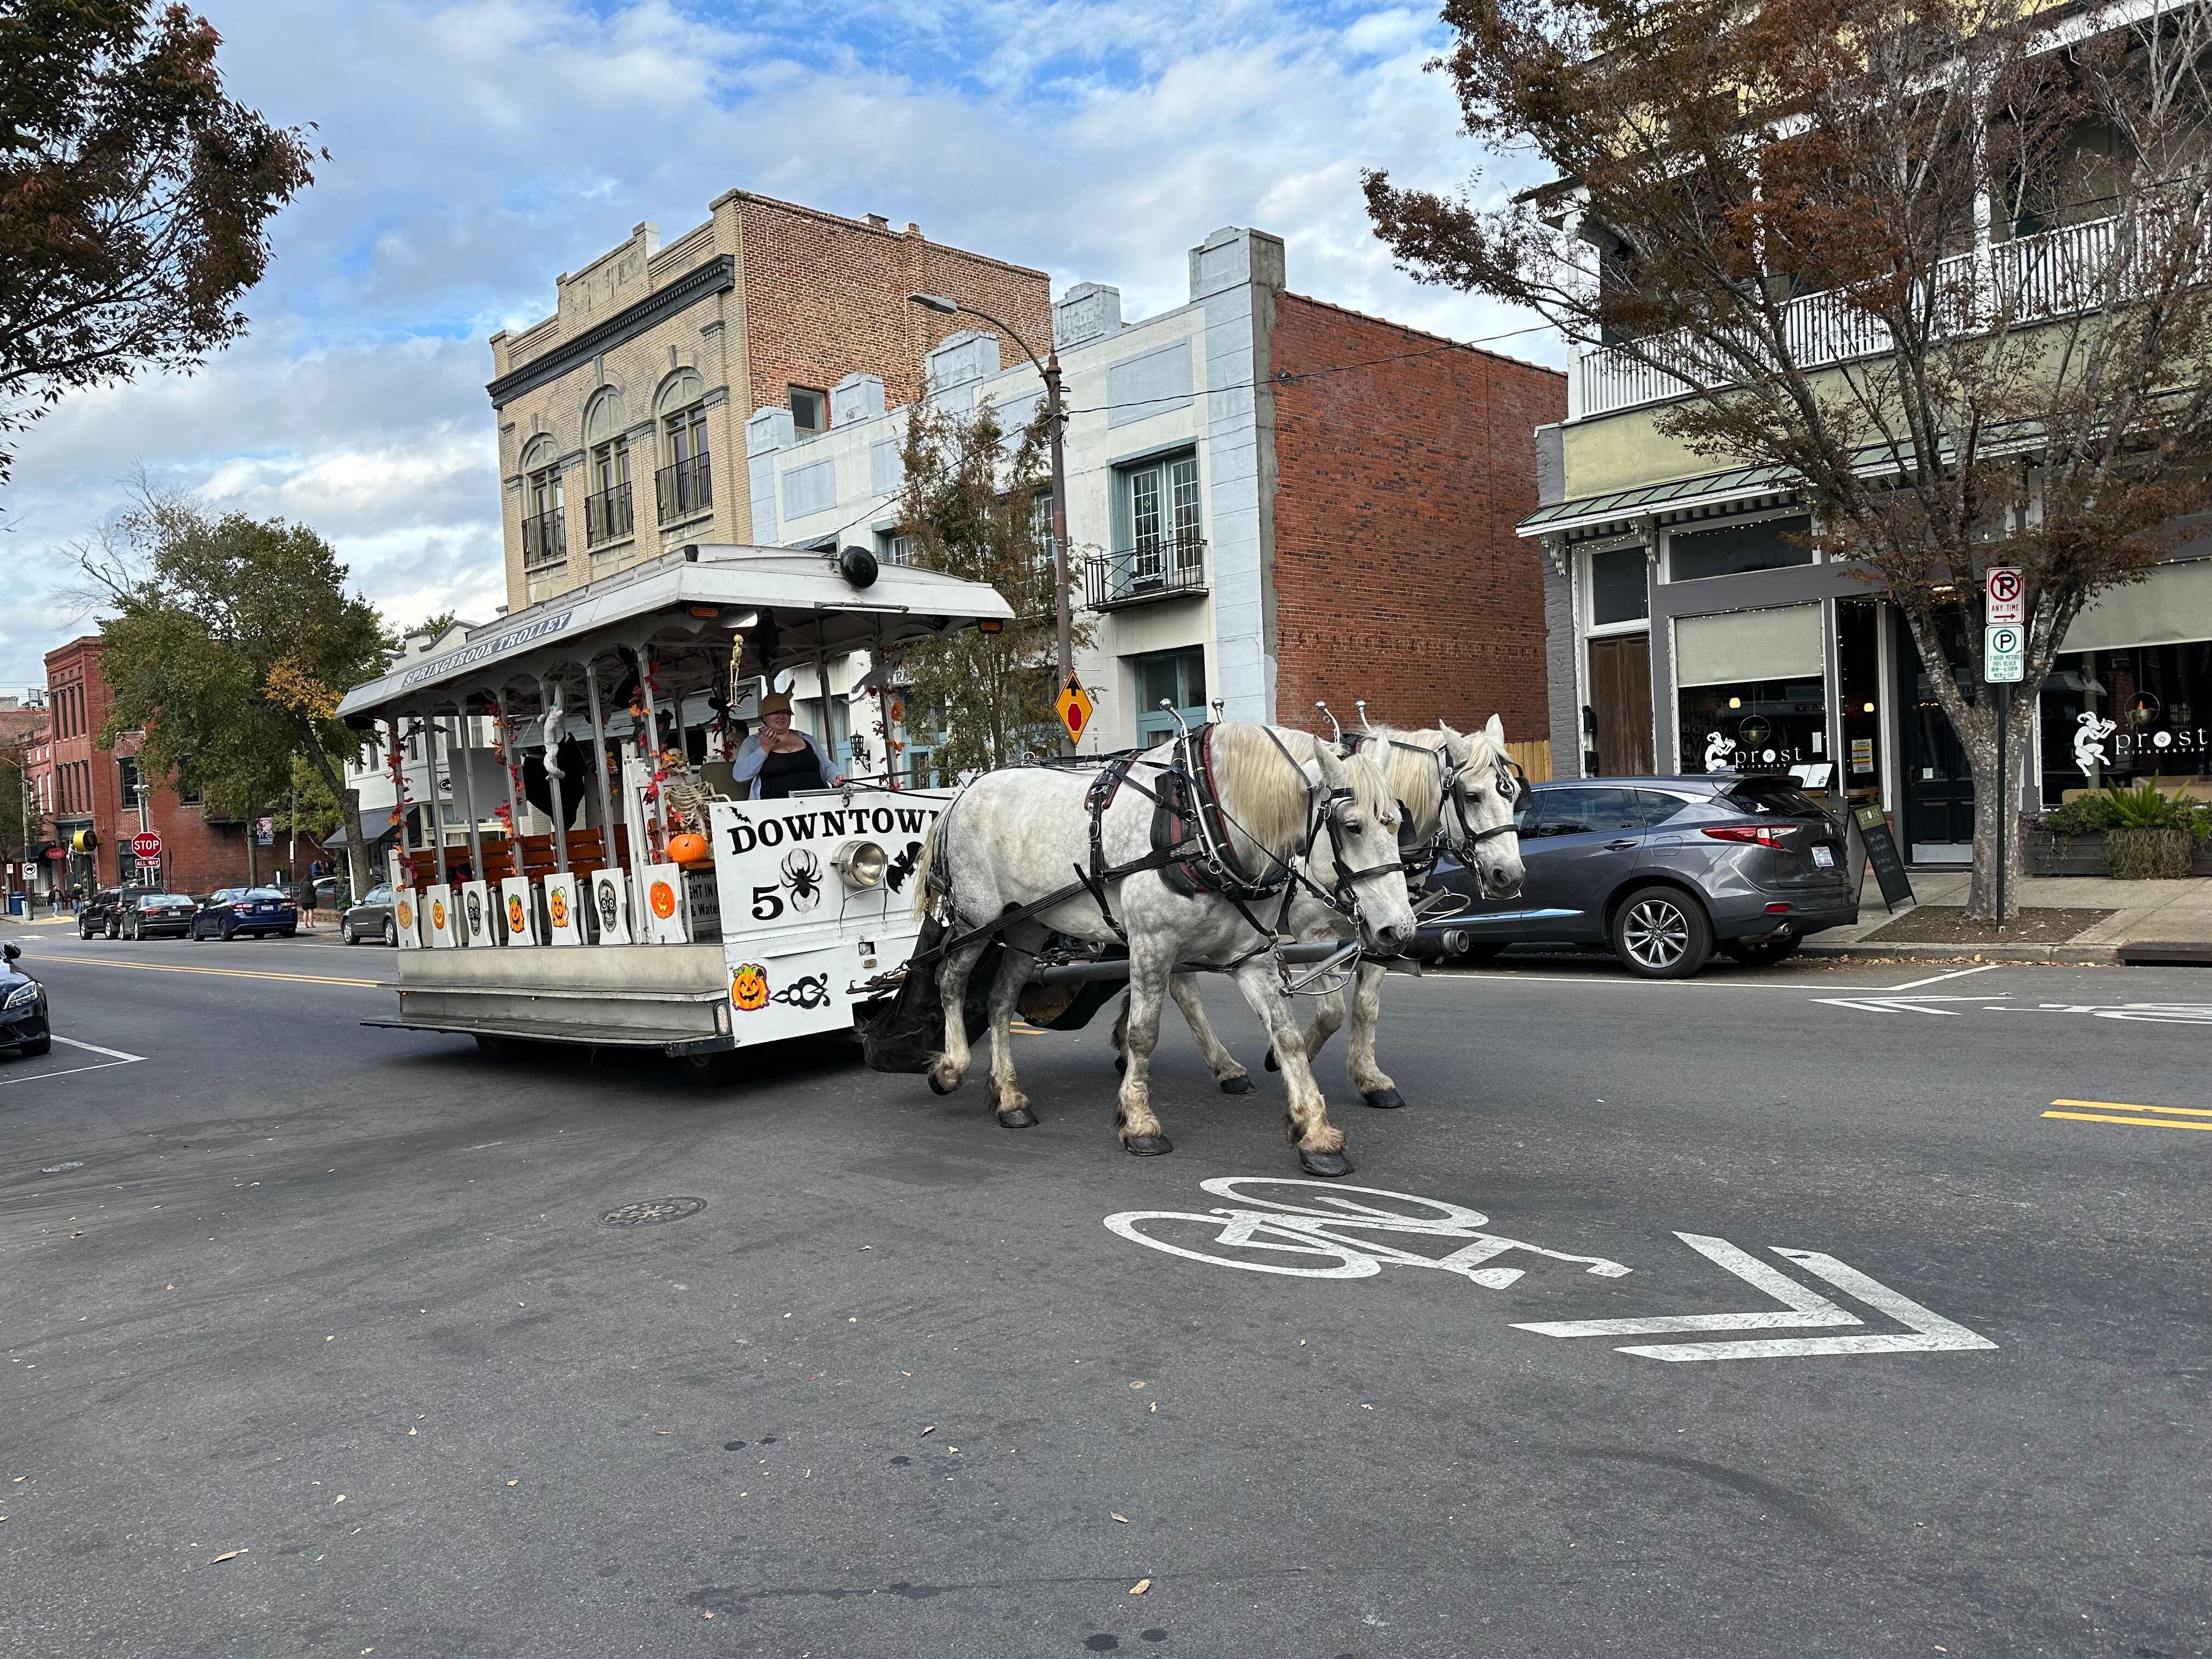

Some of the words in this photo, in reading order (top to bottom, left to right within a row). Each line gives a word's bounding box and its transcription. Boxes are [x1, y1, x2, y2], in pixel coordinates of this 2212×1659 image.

[404, 640, 496, 686] SPRINGBROOK
[496, 613, 571, 651] TROLLEY
[2000, 634, 2012, 648] P
[2115, 728, 2208, 755] prost
[1735, 747, 1802, 769] prost
[1859, 808, 1880, 825] prost
[134, 840, 159, 850] STOP
[704, 883, 713, 898] IN
[752, 884, 783, 920] 5
